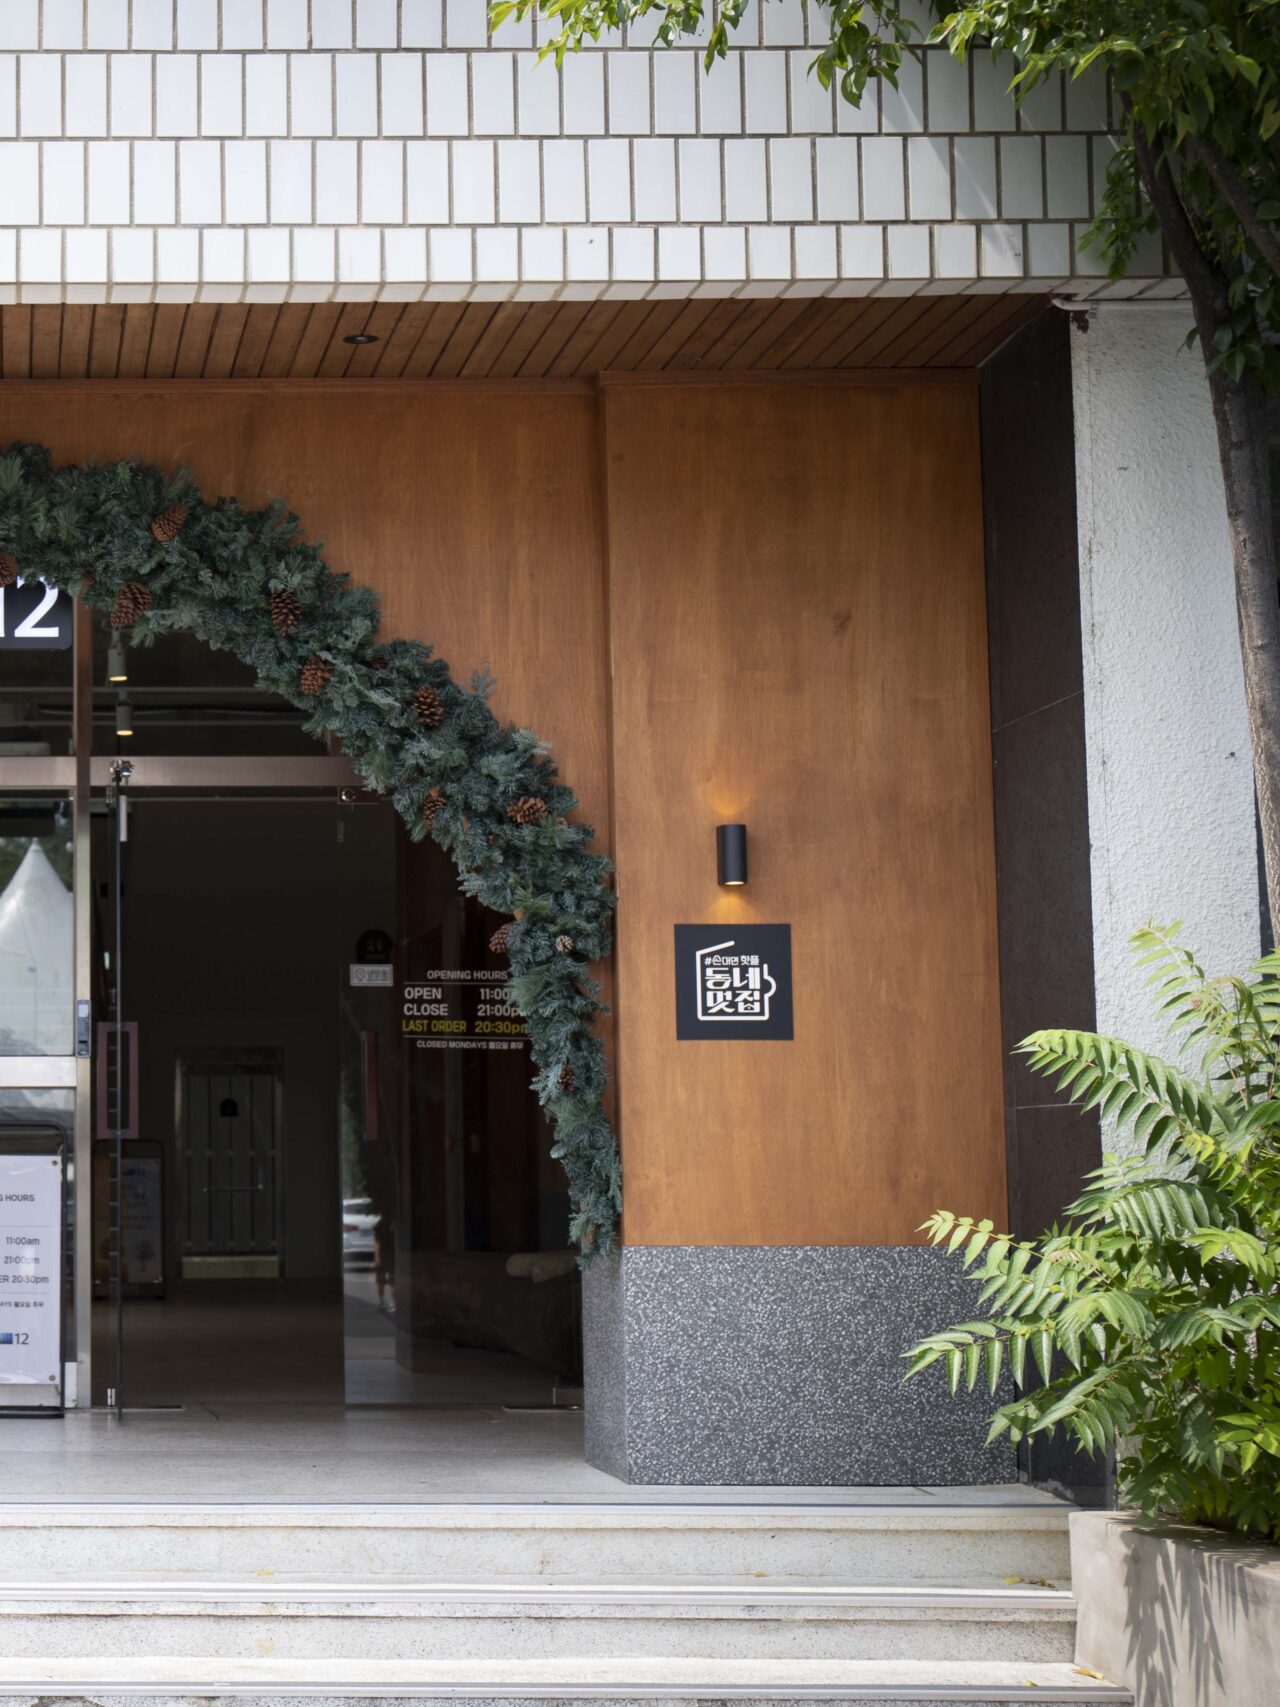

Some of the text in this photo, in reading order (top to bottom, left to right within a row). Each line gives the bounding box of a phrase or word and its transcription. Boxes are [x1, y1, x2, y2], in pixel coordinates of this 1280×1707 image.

[427, 970, 508, 980] OPENING HOURS
[705, 967, 761, 989] 동네
[404, 987, 513, 1000] OPEN 11:00
[706, 990, 761, 1013] 멋집
[403, 1004, 448, 1016] CLOSE
[402, 1020, 429, 1032] LAST
[431, 1020, 467, 1033] ORDER
[416, 1040, 447, 1048] CLOSED
[448, 1041, 487, 1049] MONDAYS
[5, 1194, 35, 1202] HOURS
[5, 1237, 40, 1246] 11:00am
[11, 1275, 49, 1285] 20:30pm
[14, 1332, 29, 1345] 12
